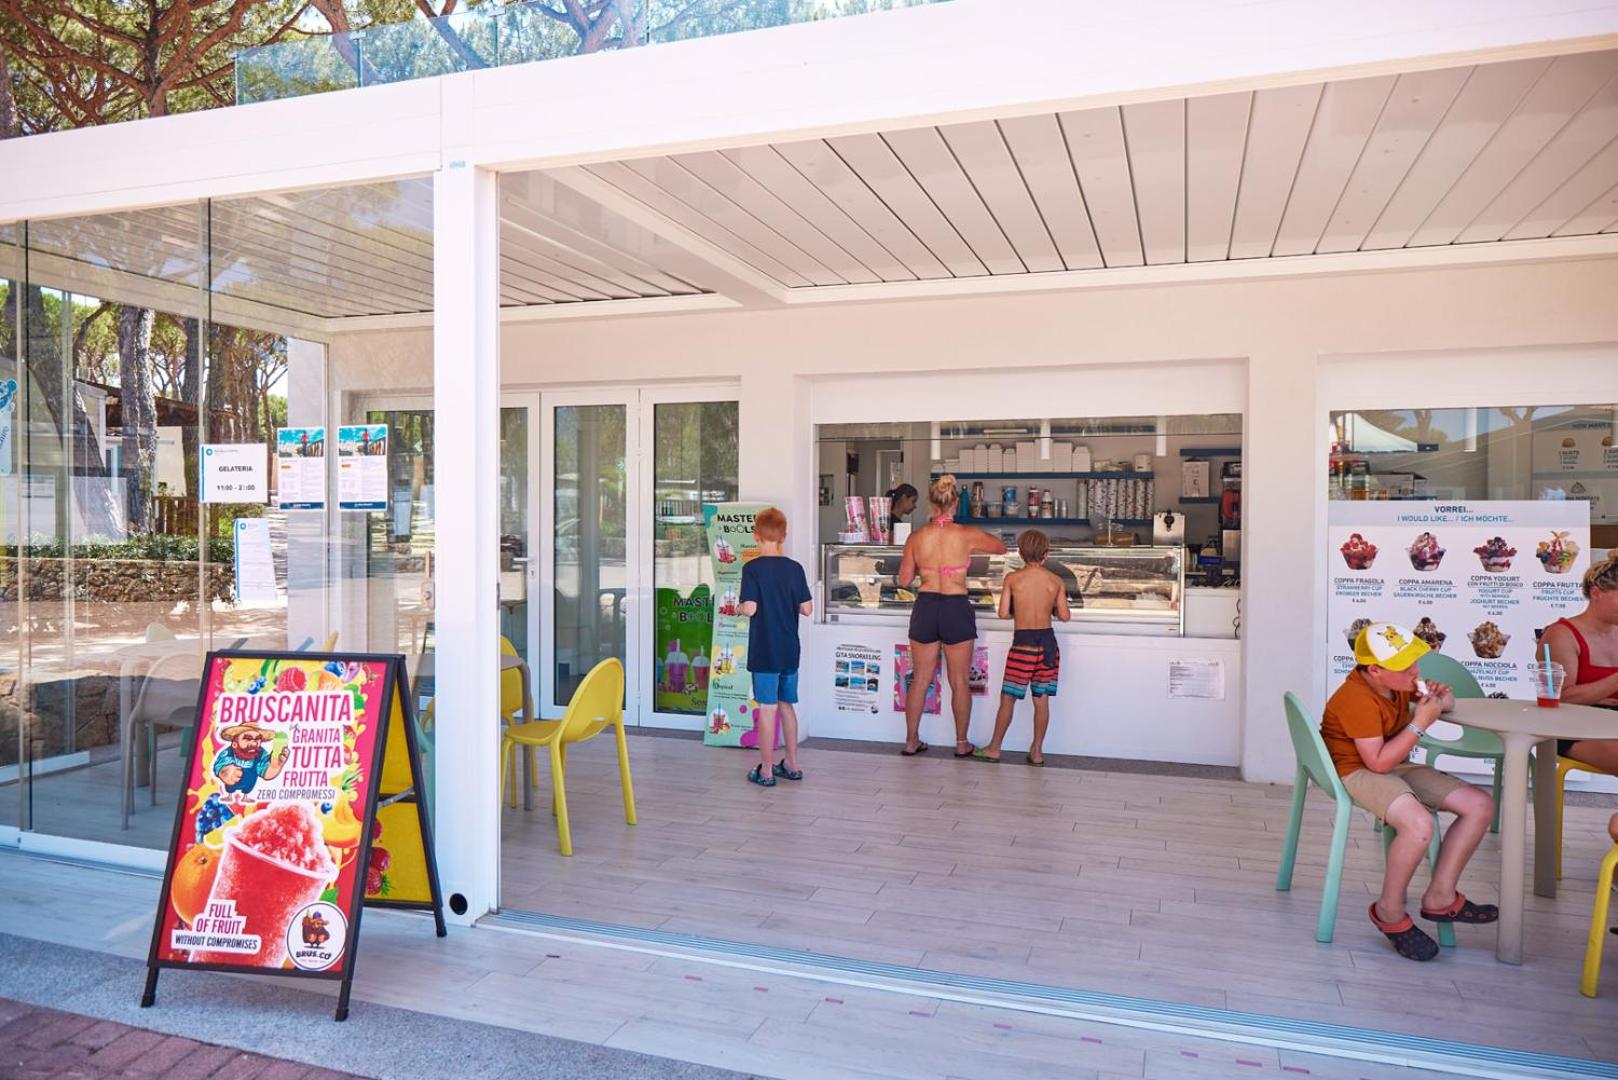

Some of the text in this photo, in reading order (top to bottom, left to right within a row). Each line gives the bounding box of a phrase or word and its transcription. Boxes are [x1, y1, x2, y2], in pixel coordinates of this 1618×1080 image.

[218, 465, 253, 473] GELATERIA
[717, 514, 757, 523] MASTE
[1483, 661, 1517, 669] NOCCIOLA
[220, 694, 351, 723] BRUSCANITA
[292, 728, 341, 744] GRANITA
[292, 745, 342, 769] TUTTA
[282, 770, 328, 788] FRUTTA
[256, 789, 336, 801] ZERO COMPROMESSI
[208, 903, 233, 919] FULL
[196, 917, 243, 935] OF FRUIT
[175, 934, 259, 951] WITHOUT COMPROMISES
